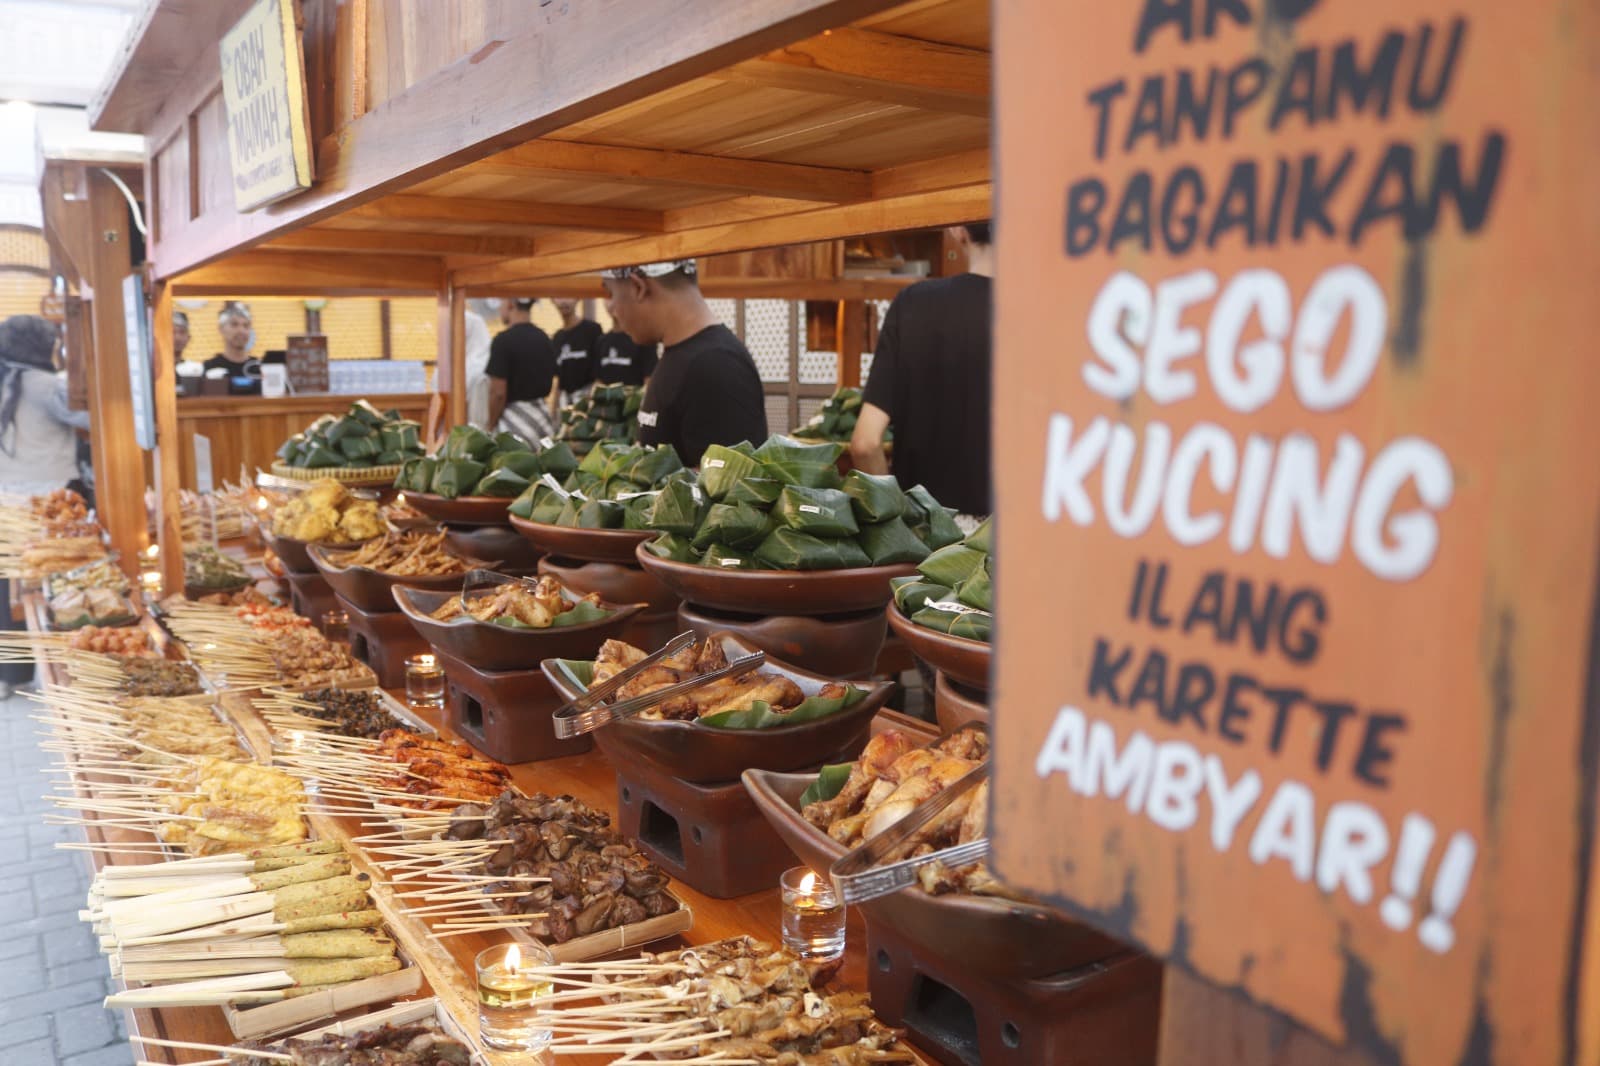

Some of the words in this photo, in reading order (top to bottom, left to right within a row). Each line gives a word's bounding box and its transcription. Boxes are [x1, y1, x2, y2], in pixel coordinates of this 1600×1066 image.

[232, 87, 281, 165] MAMAH
[234, 24, 267, 99] OBAH
[1086, 17, 1468, 159] TANPAMU
[1063, 128, 1507, 259] BAGAIKAN
[1082, 264, 1387, 413] SEGO
[1042, 412, 1454, 581] KUCING
[1127, 557, 1329, 666] ILANG
[1086, 637, 1408, 789] KARETTE
[1036, 705, 1476, 953] AMBYAR!!
